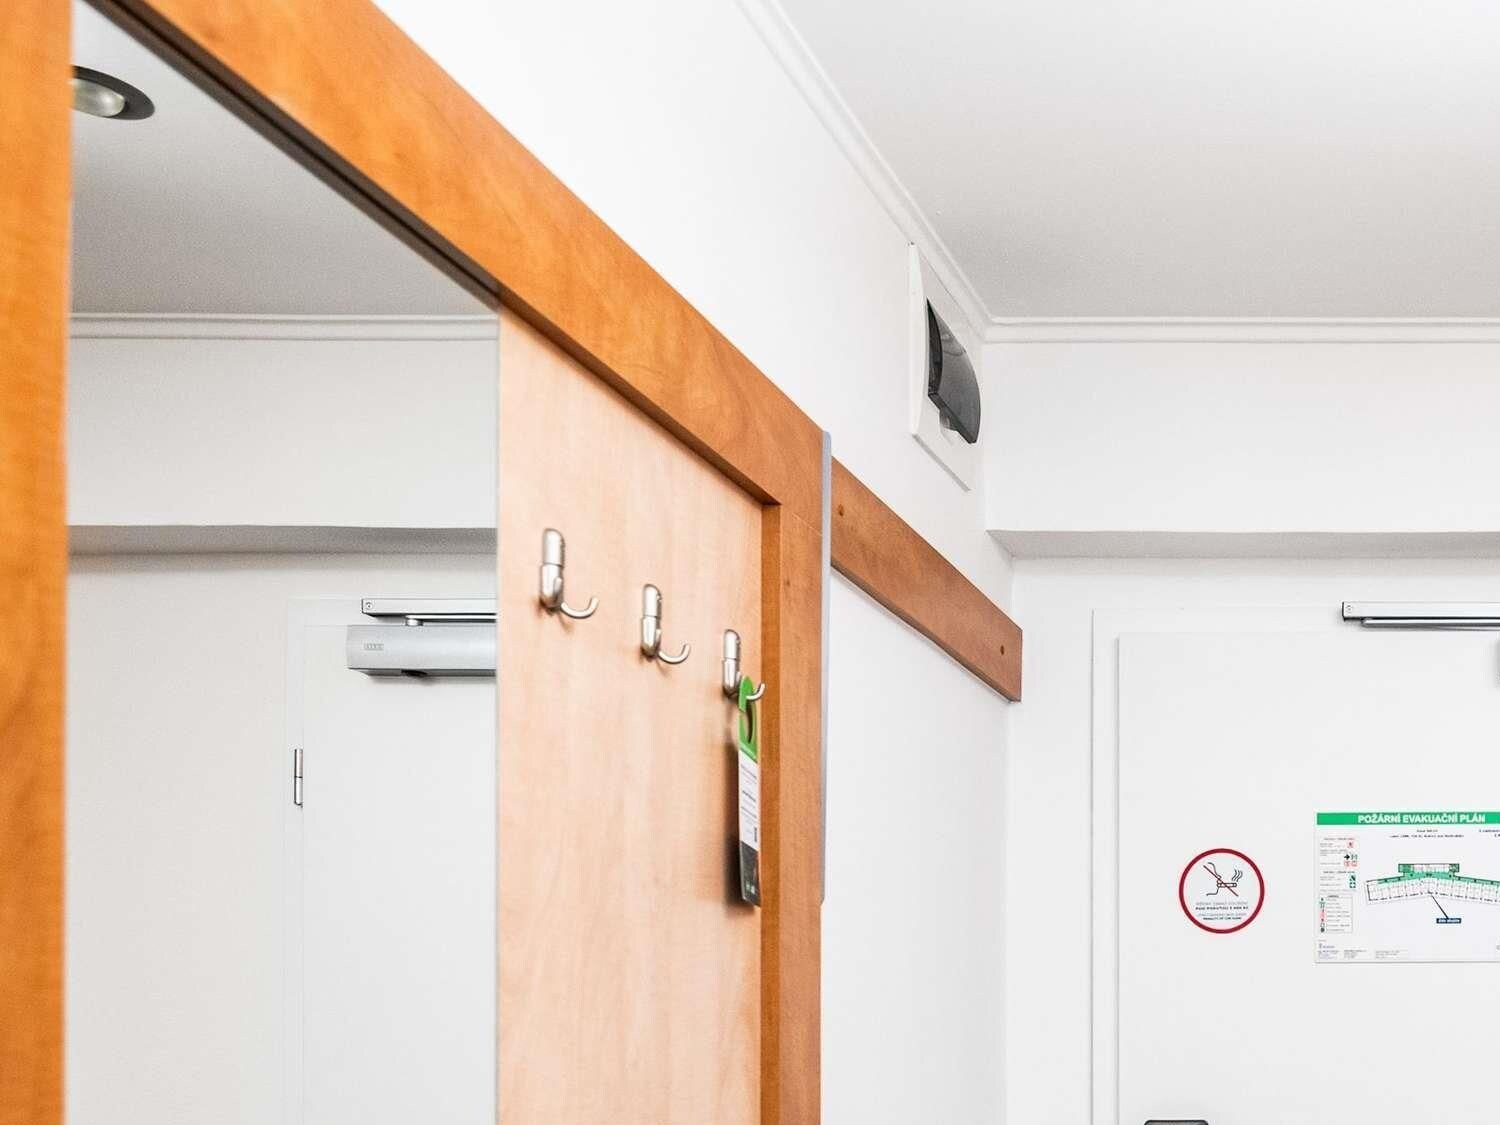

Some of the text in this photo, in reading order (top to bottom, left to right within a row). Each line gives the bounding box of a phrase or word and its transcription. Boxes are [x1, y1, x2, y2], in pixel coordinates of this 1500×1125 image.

[1357, 812, 1486, 824] POŽÁRNÍ EVAKUAČNÍ PLÁN
